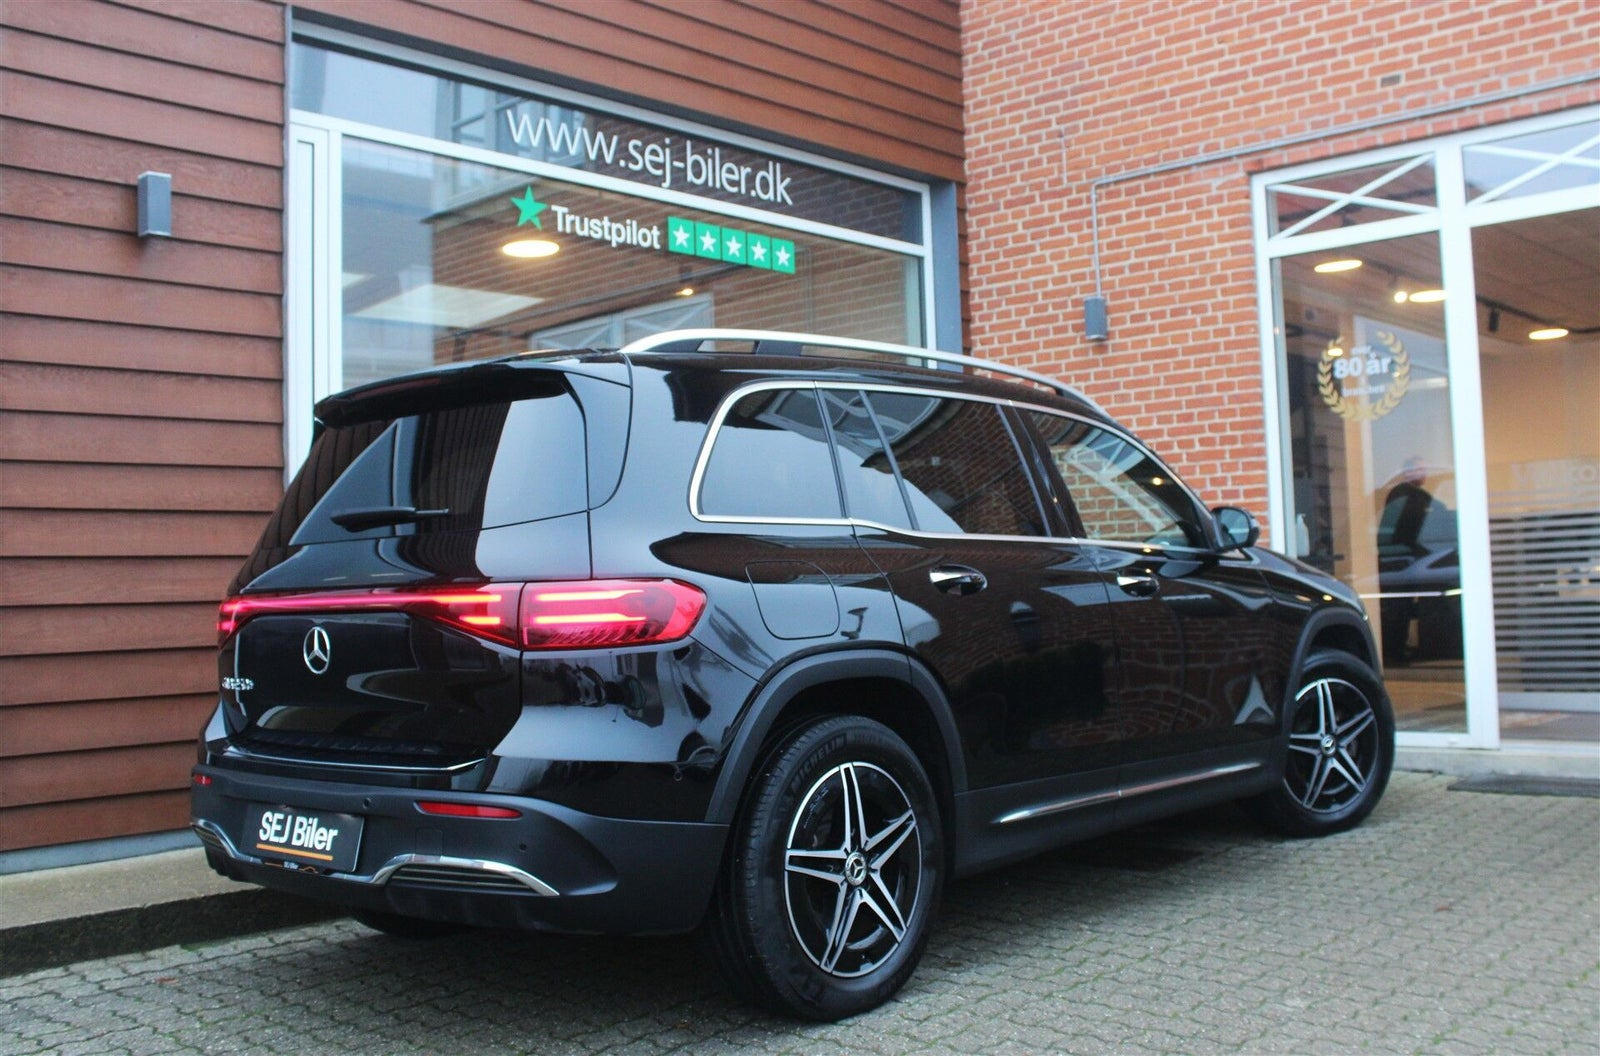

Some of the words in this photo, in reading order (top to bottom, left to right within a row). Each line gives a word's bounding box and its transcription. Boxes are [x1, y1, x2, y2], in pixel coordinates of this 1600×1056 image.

[506, 109, 793, 206] www.sej-biler.dk
[551, 205, 661, 249] Trustpilot
[1333, 357, 1362, 379] 80
[1366, 352, 1392, 374] år
[259, 810, 292, 843] SEJ
[291, 815, 339, 851] Biler
